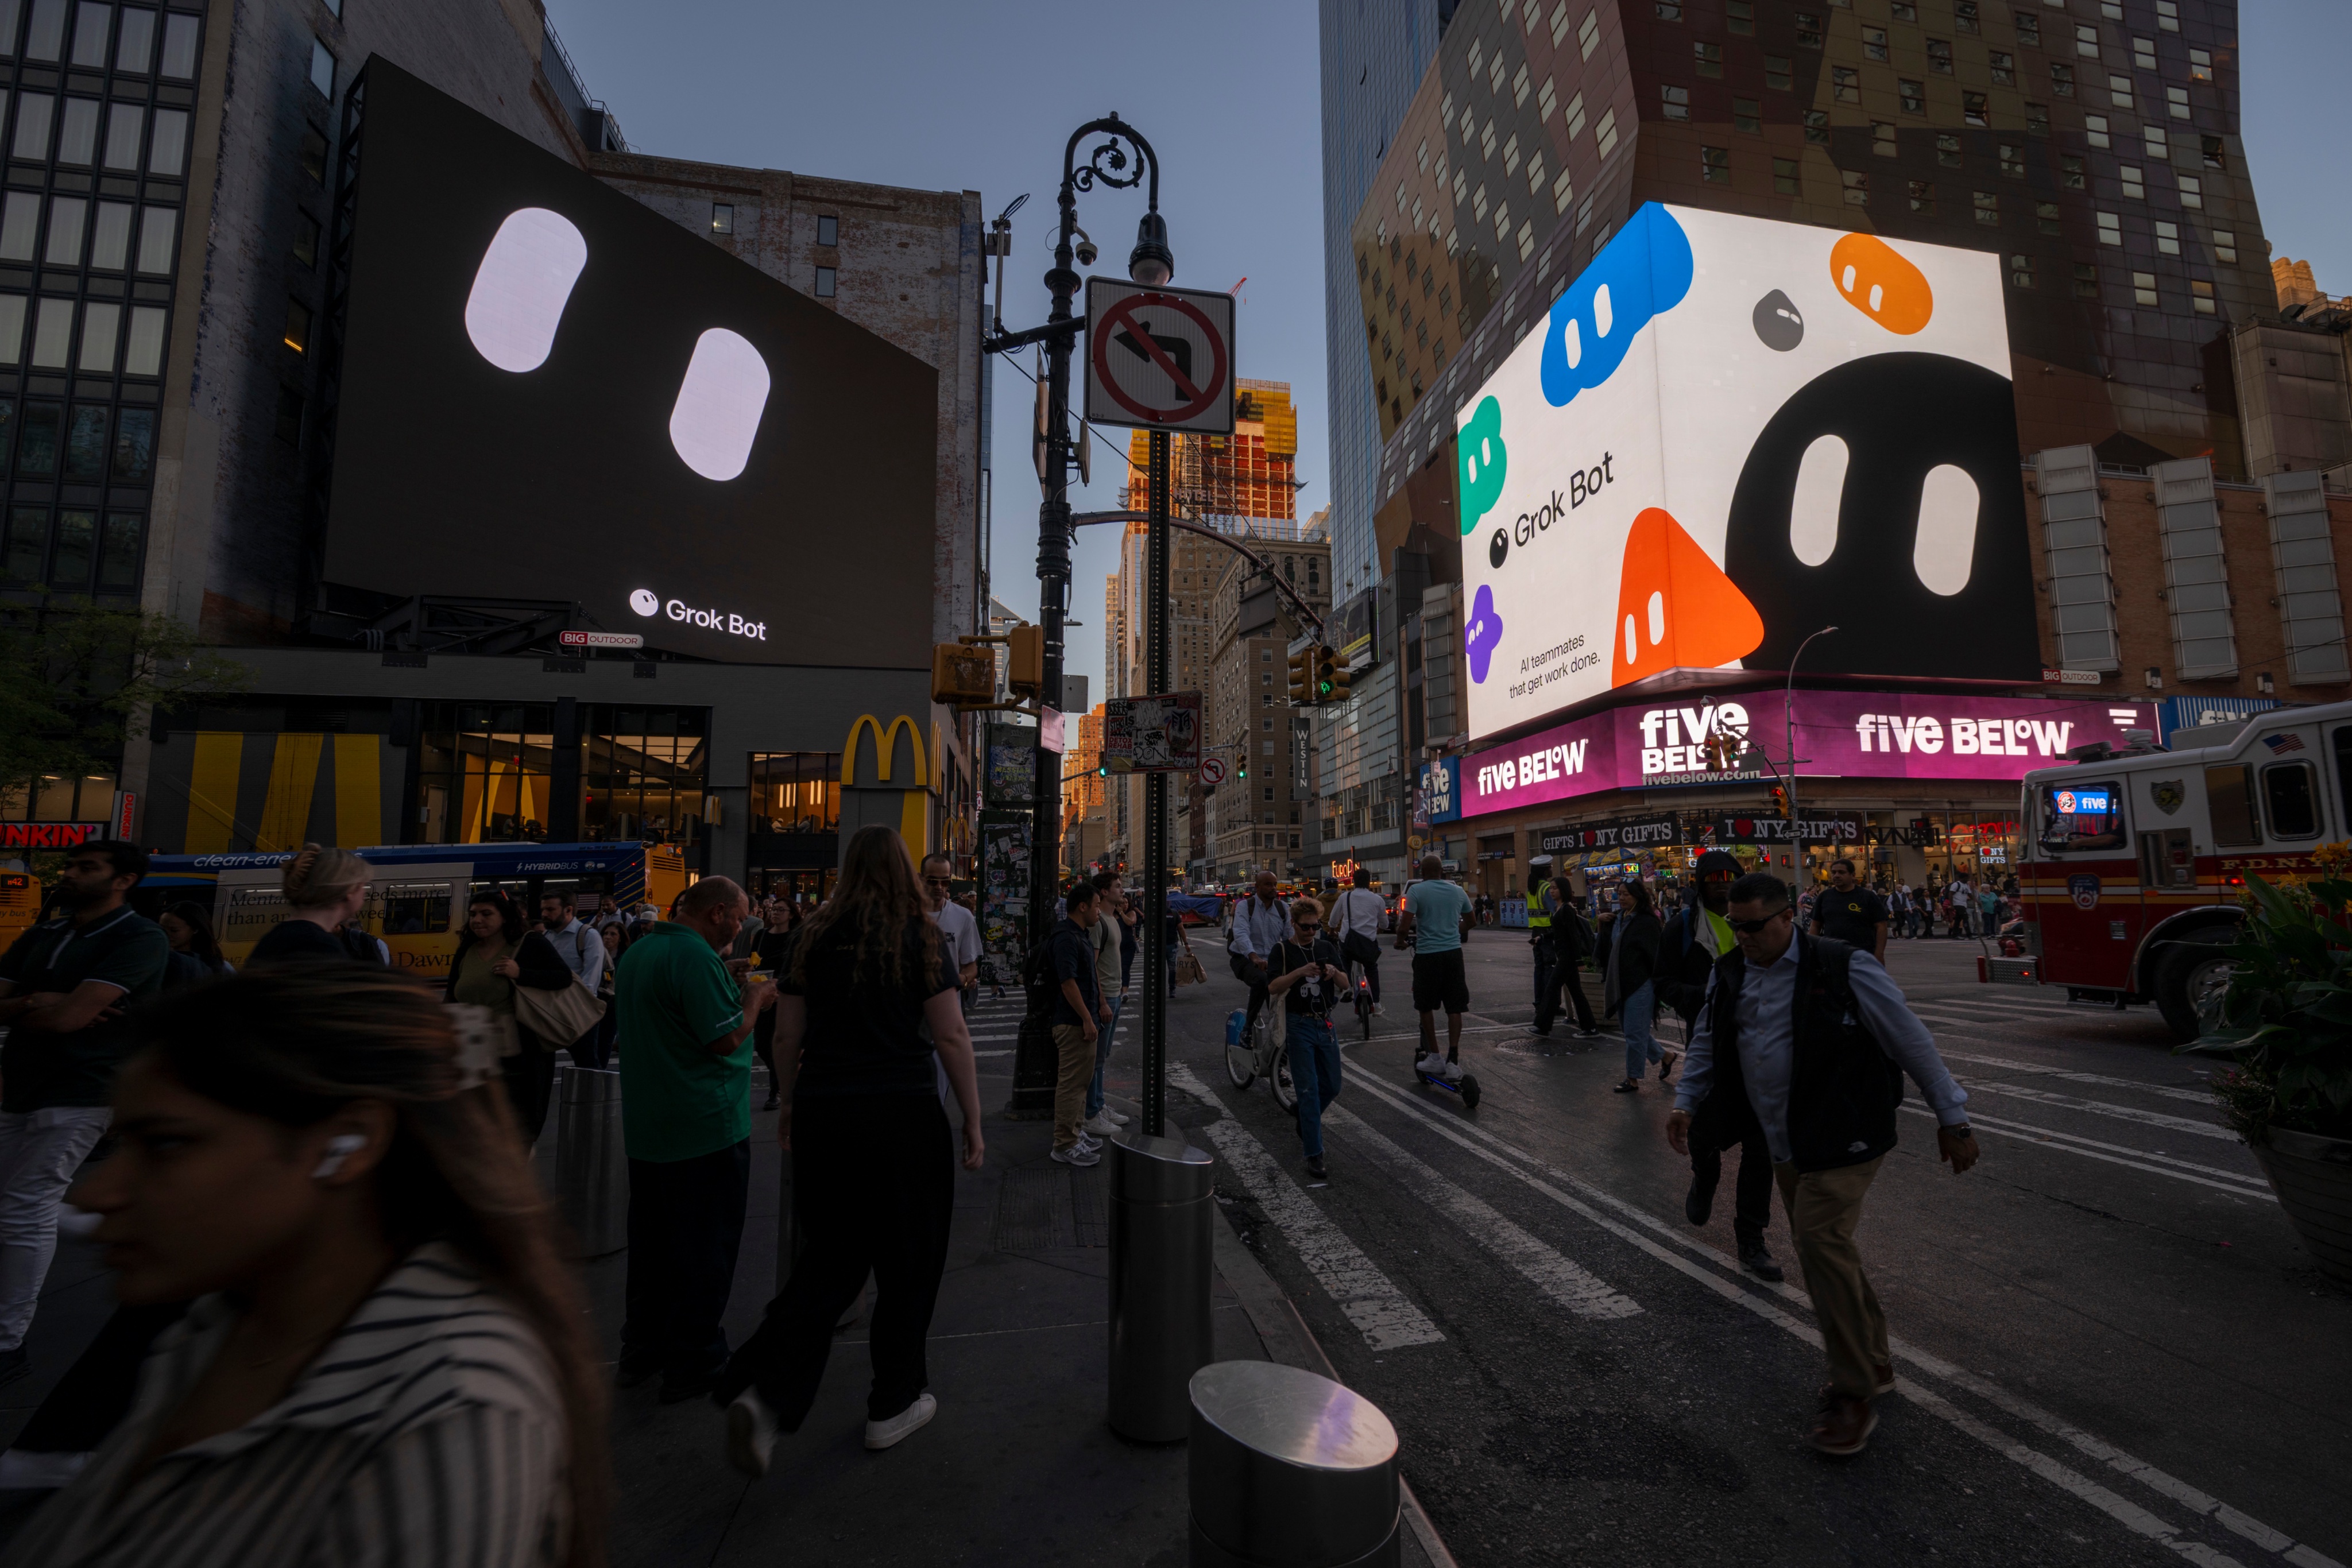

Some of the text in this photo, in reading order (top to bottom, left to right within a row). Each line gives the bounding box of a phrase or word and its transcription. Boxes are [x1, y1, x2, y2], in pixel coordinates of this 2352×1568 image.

[1515, 451, 1614, 547] Grok Bot
[666, 599, 766, 641] Grok Bot
[564, 633, 638, 644] BIG OUTDOOR
[1521, 634, 1584, 674] AI teammates
[1510, 652, 1600, 699] that get work done.
[2044, 671, 2098, 682] BIG OUTDOOR
[1640, 703, 1749, 748] five
[1856, 714, 2070, 756] five BELOW
[1296, 730, 1309, 787] WESTIN
[1478, 738, 1586, 796] five BELOW
[1642, 771, 1761, 786] fivebelow.com
[1428, 795, 1449, 815] ELOW
[2082, 797, 2107, 810] five
[121, 794, 134, 839] DUNKIN'
[0, 824, 94, 847] NKIN'
[1544, 835, 1574, 850] GIFTS
[1579, 832, 1585, 847] I
[1622, 822, 1672, 843] GIFTS
[1725, 819, 1735, 838] I
[194, 854, 293, 868] clean-ene
[1990, 847, 2004, 855] NY
[524, 862, 579, 871] HYBRIDBUS
[7, 877, 23, 886] M42
[231, 889, 445, 907] Menta eeds more
[228, 911, 266, 924] than
[356, 909, 385, 919] wee
